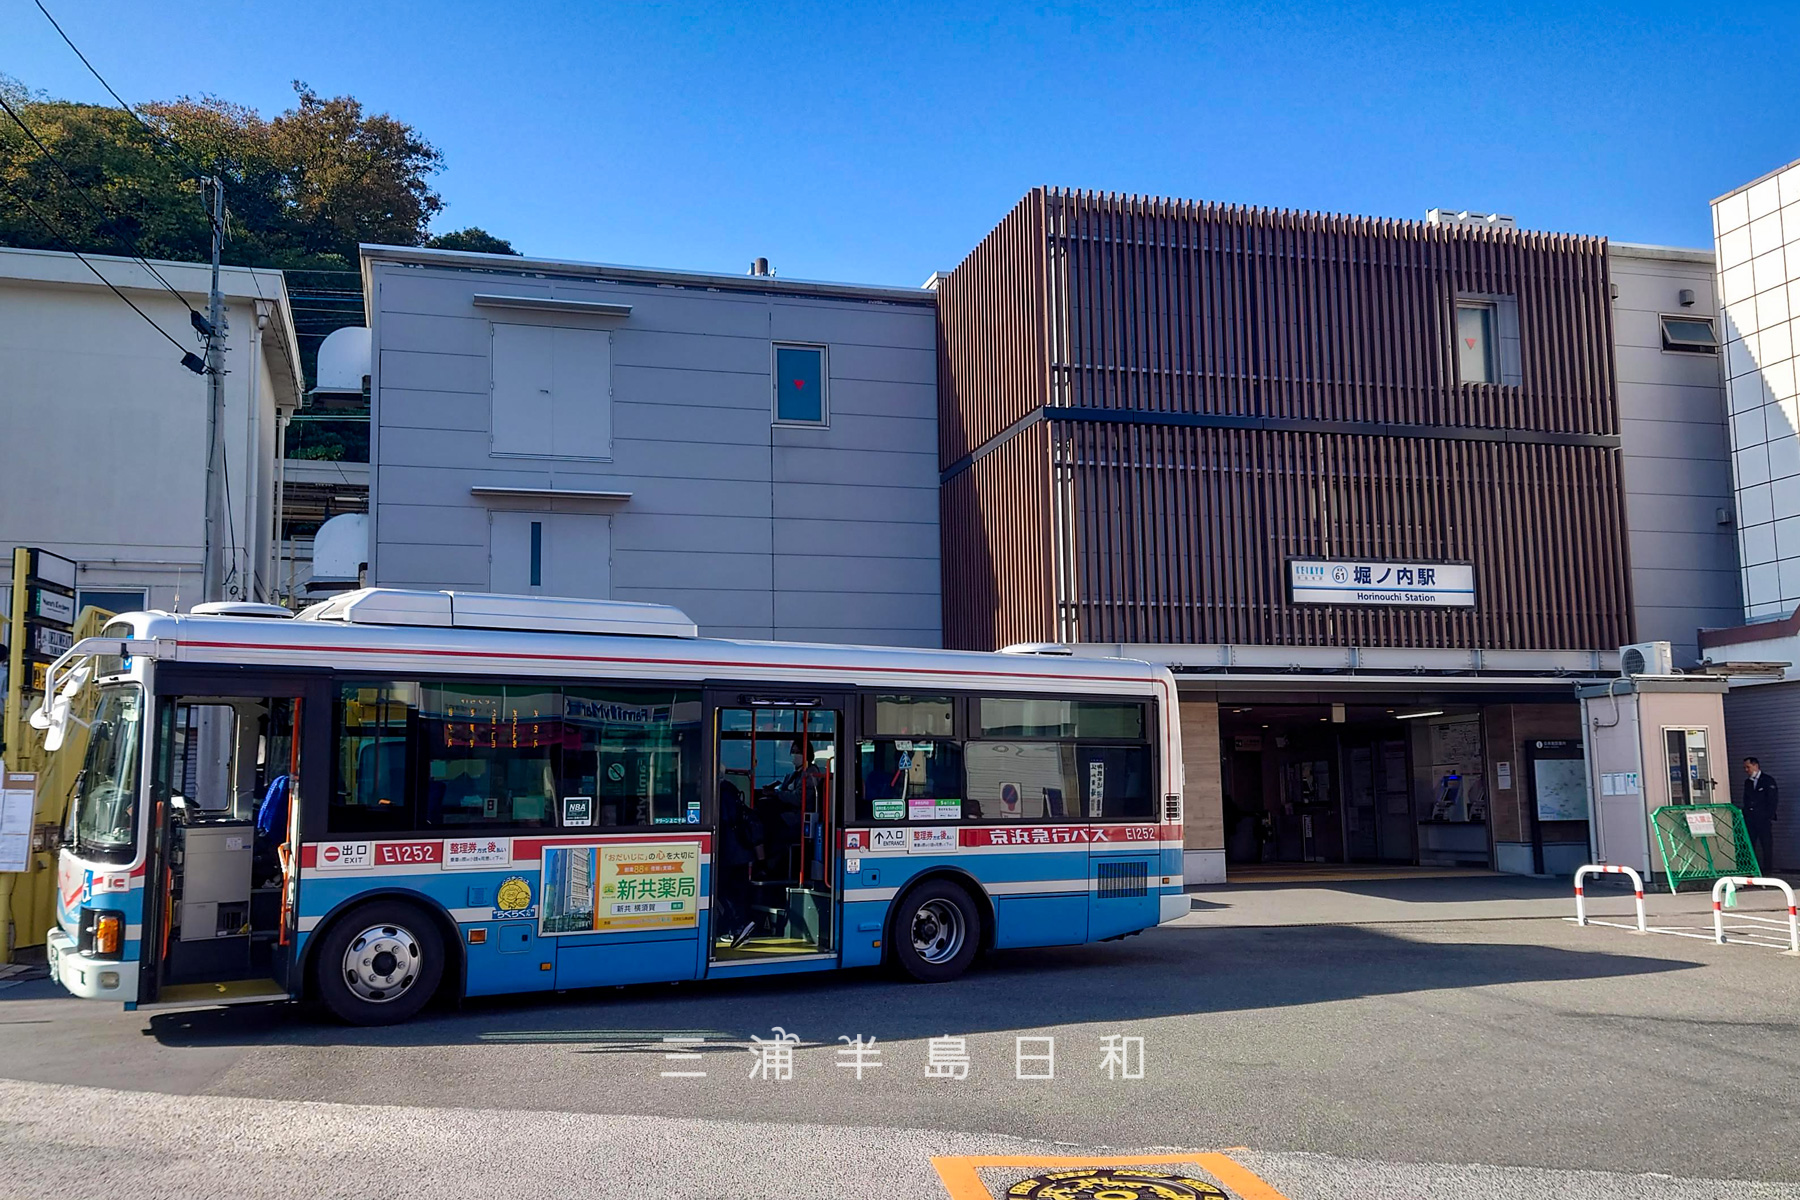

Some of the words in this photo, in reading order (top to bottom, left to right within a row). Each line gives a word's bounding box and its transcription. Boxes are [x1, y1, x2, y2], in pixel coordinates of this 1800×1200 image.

[1335, 572, 1345, 581] 61
[1353, 566, 1436, 586] 堀ノ内駅
[1357, 593, 1402, 602] Horinouchi
[1405, 593, 1436, 602] Station
[569, 803, 586, 812] NBA
[886, 830, 903, 839] 入口
[989, 828, 1109, 845] 京浜急行バス
[1125, 827, 1155, 840] E1252
[342, 844, 367, 856] 出口
[382, 845, 435, 863] E1252
[617, 877, 696, 900] 新共薬局
[617, 904, 631, 912] 新共
[634, 903, 656, 912] 横須賀
